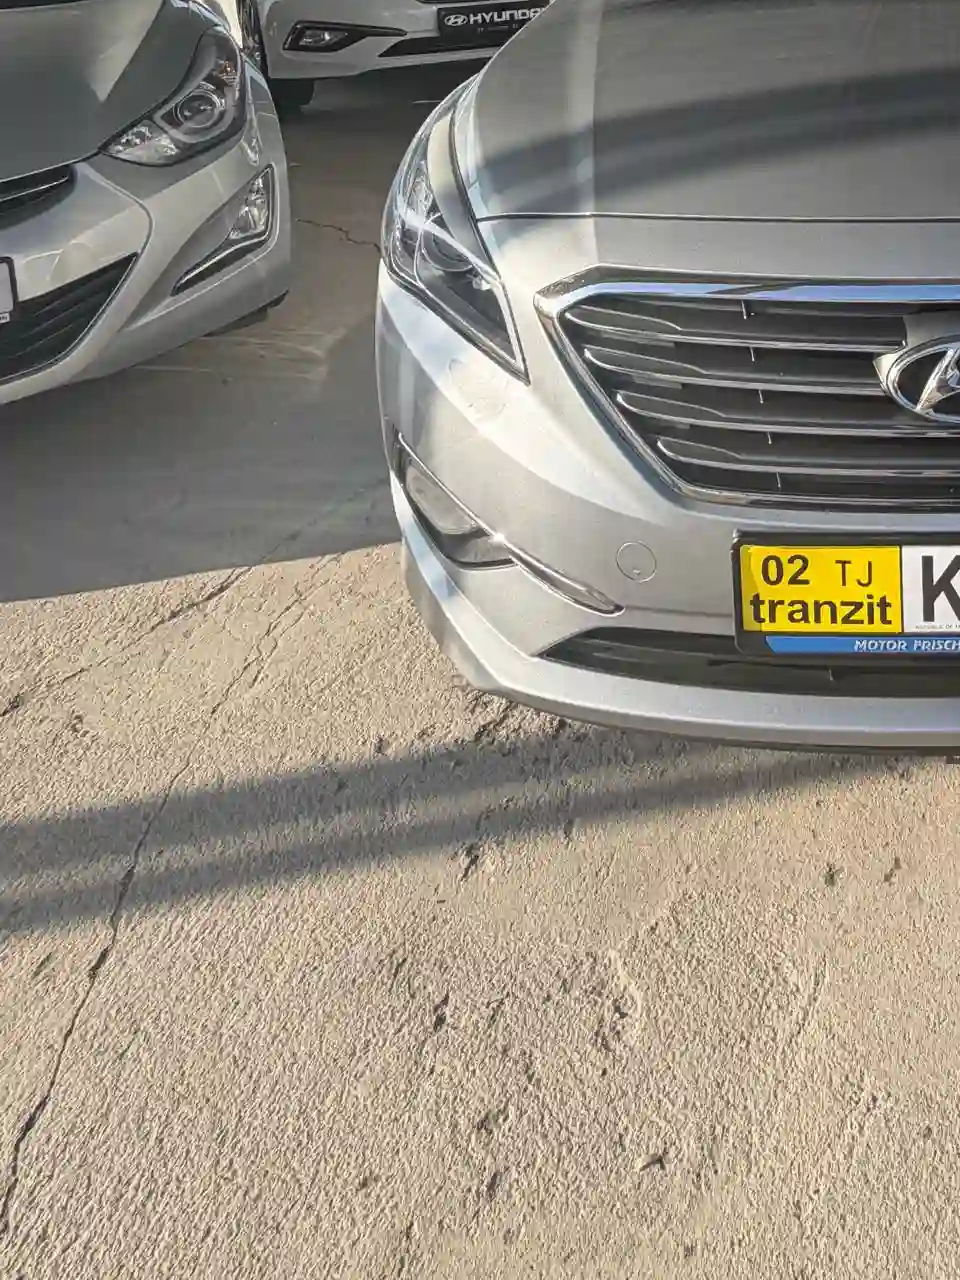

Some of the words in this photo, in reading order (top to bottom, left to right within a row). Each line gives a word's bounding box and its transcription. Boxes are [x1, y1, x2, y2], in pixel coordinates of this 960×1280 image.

[469, 7, 545, 25] HYUNDA
[761, 554, 810, 586] 02
[835, 560, 873, 587] TJ
[750, 593, 892, 625] tranzit
[853, 639, 908, 652] MOTOR
